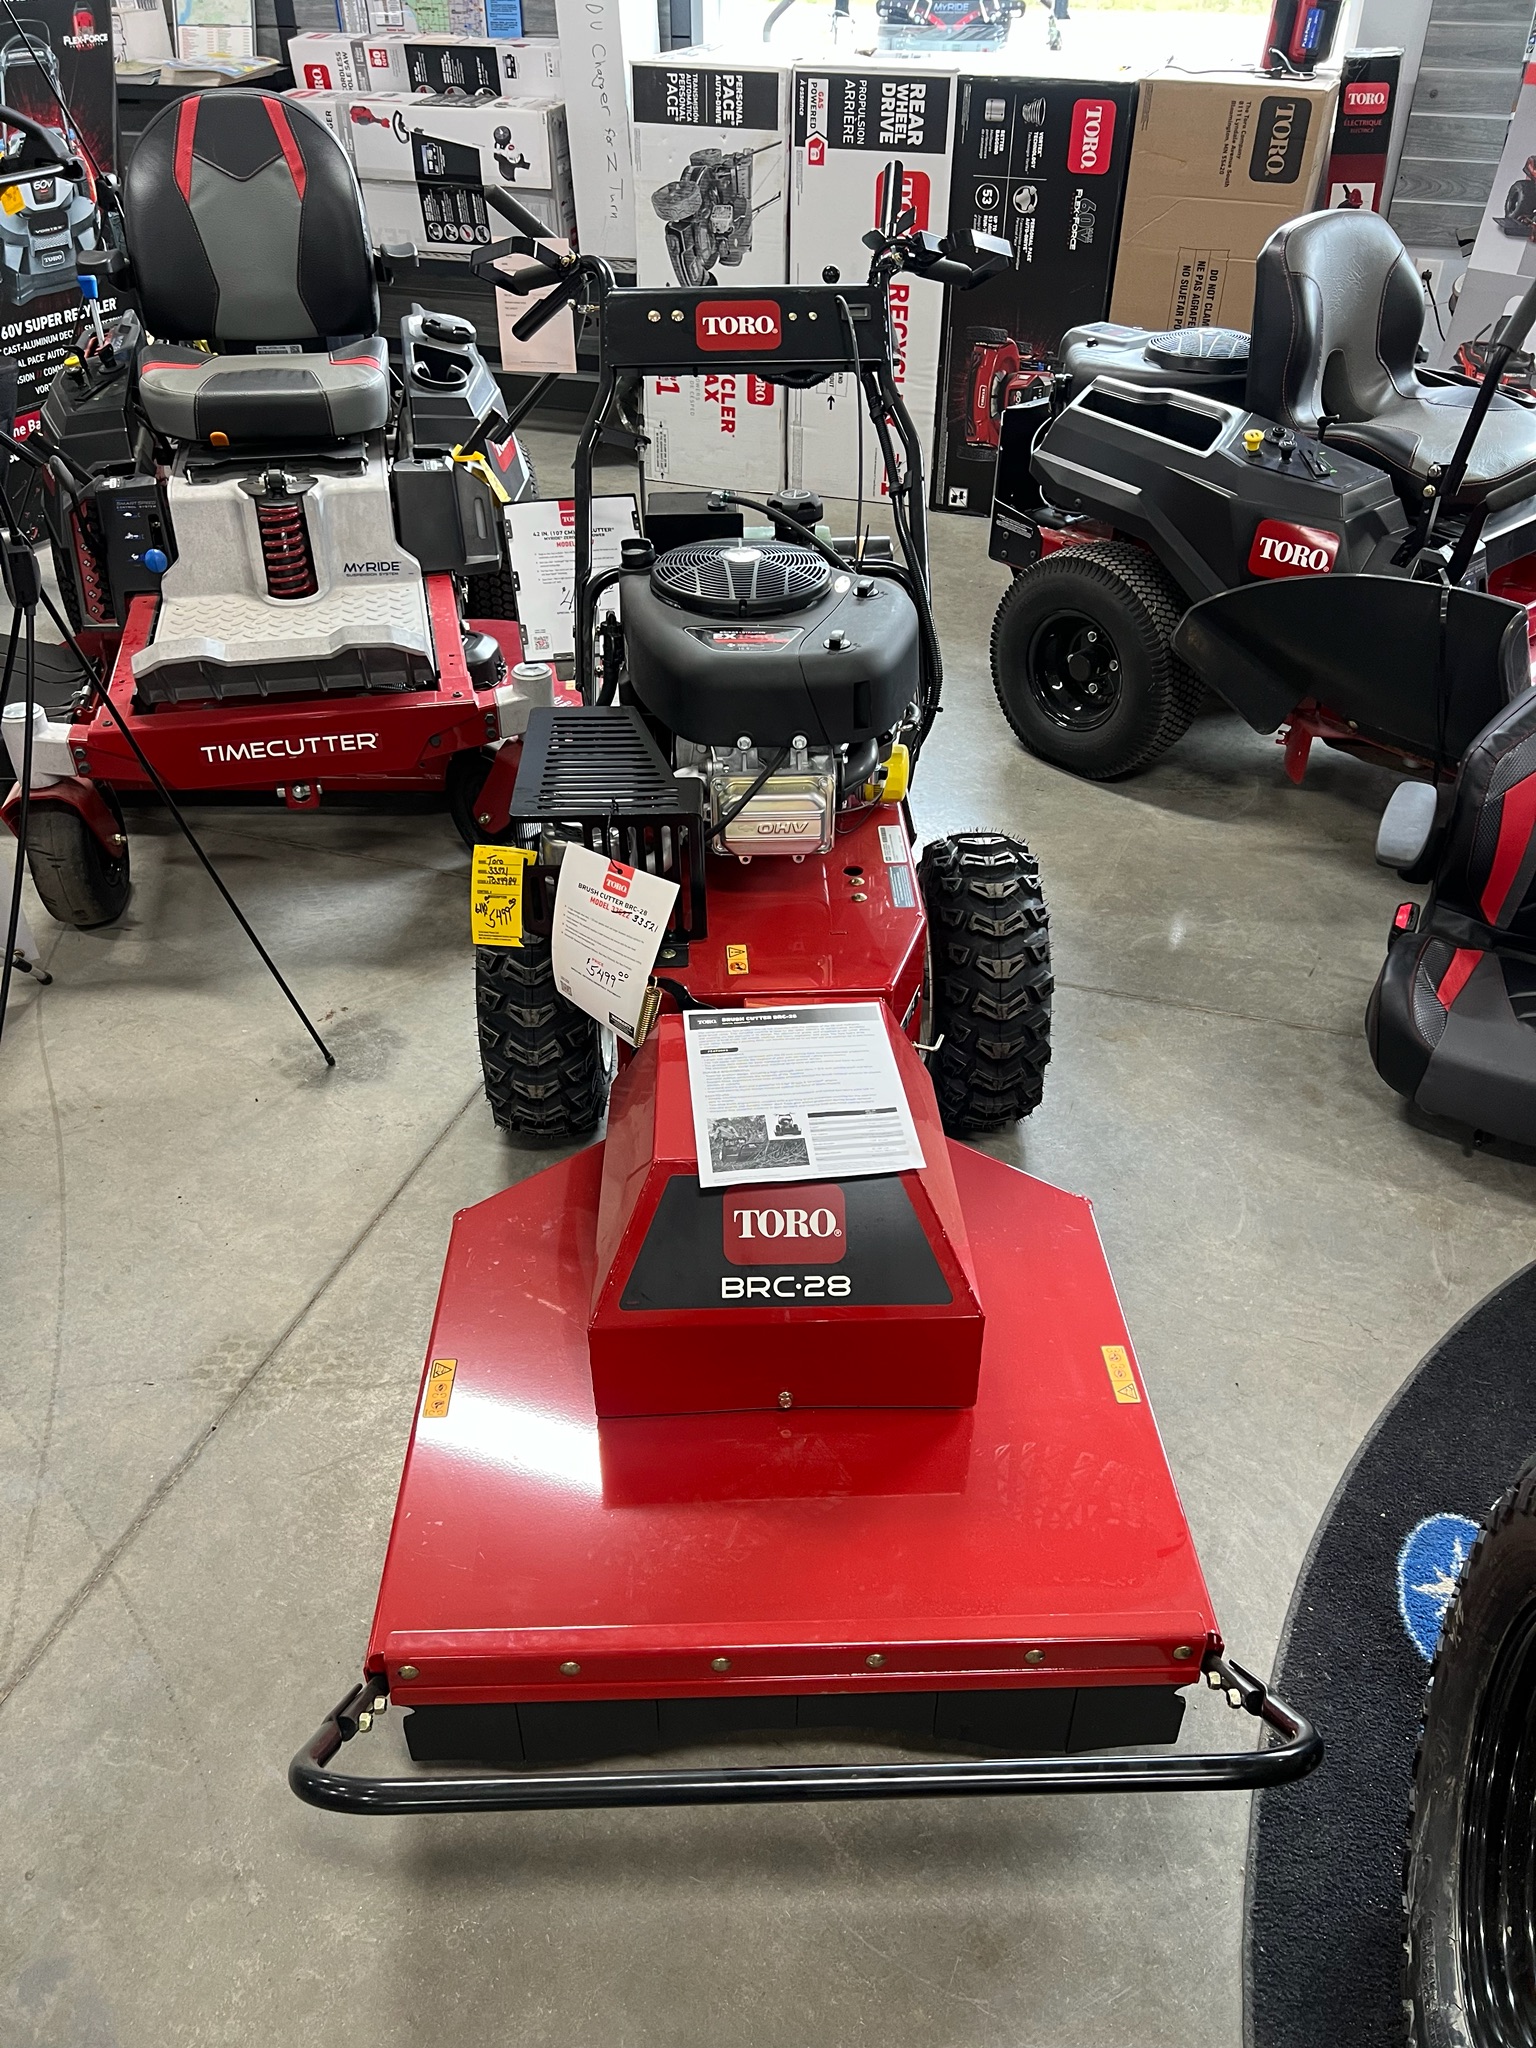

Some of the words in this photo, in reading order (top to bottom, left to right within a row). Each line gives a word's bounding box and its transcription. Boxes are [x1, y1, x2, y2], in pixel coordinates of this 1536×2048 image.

[810, 82, 818, 129] POWERED
[843, 79, 857, 144] ARRIÈRE
[856, 80, 867, 145] PROPULSION
[879, 83, 897, 144] DRIVE
[895, 83, 909, 144] WHEEL
[1348, 93, 1384, 105] TORO
[907, 83, 926, 146] REAR
[1080, 105, 1103, 168] TORO
[1232, 119, 1241, 143] Lyndale
[1236, 130, 1246, 159] Company
[1266, 103, 1295, 174] TORO
[1222, 144, 1229, 153] MN
[1228, 145, 1236, 168] Avenue
[33, 180, 53, 190] 60V
[1224, 170, 1232, 187] South
[609, 178, 624, 219] Turn
[982, 189, 993, 205] 53
[1069, 189, 1083, 250] FLEX-FORCE
[1182, 265, 1191, 277] NO
[1196, 261, 1206, 272] NE
[1210, 269, 1218, 281] DO
[1175, 279, 1189, 316] SUJETAR
[1194, 275, 1203, 292] PAS
[1207, 284, 1216, 301] NOT
[1, 325, 23, 340] 60V
[25, 312, 62, 333] SUPER
[63, 298, 117, 324] REYLER
[1188, 293, 1200, 328] AGRAFE
[702, 315, 776, 336] TORO
[3, 332, 58, 356] CAST-ALUMINUM
[705, 374, 719, 403] AX
[344, 562, 400, 573] MyRIDE
[1260, 537, 1328, 570] TORO
[200, 733, 377, 762] TIMECUTTER
[757, 821, 809, 835] OHV
[578, 883, 599, 896] BRUSH
[600, 892, 624, 907] CUTTER
[624, 903, 648, 916] BRC-28
[606, 879, 627, 893] TORO
[590, 897, 610, 910] MODEL
[632, 915, 659, 932] 33521
[734, 1208, 837, 1239] TORO
